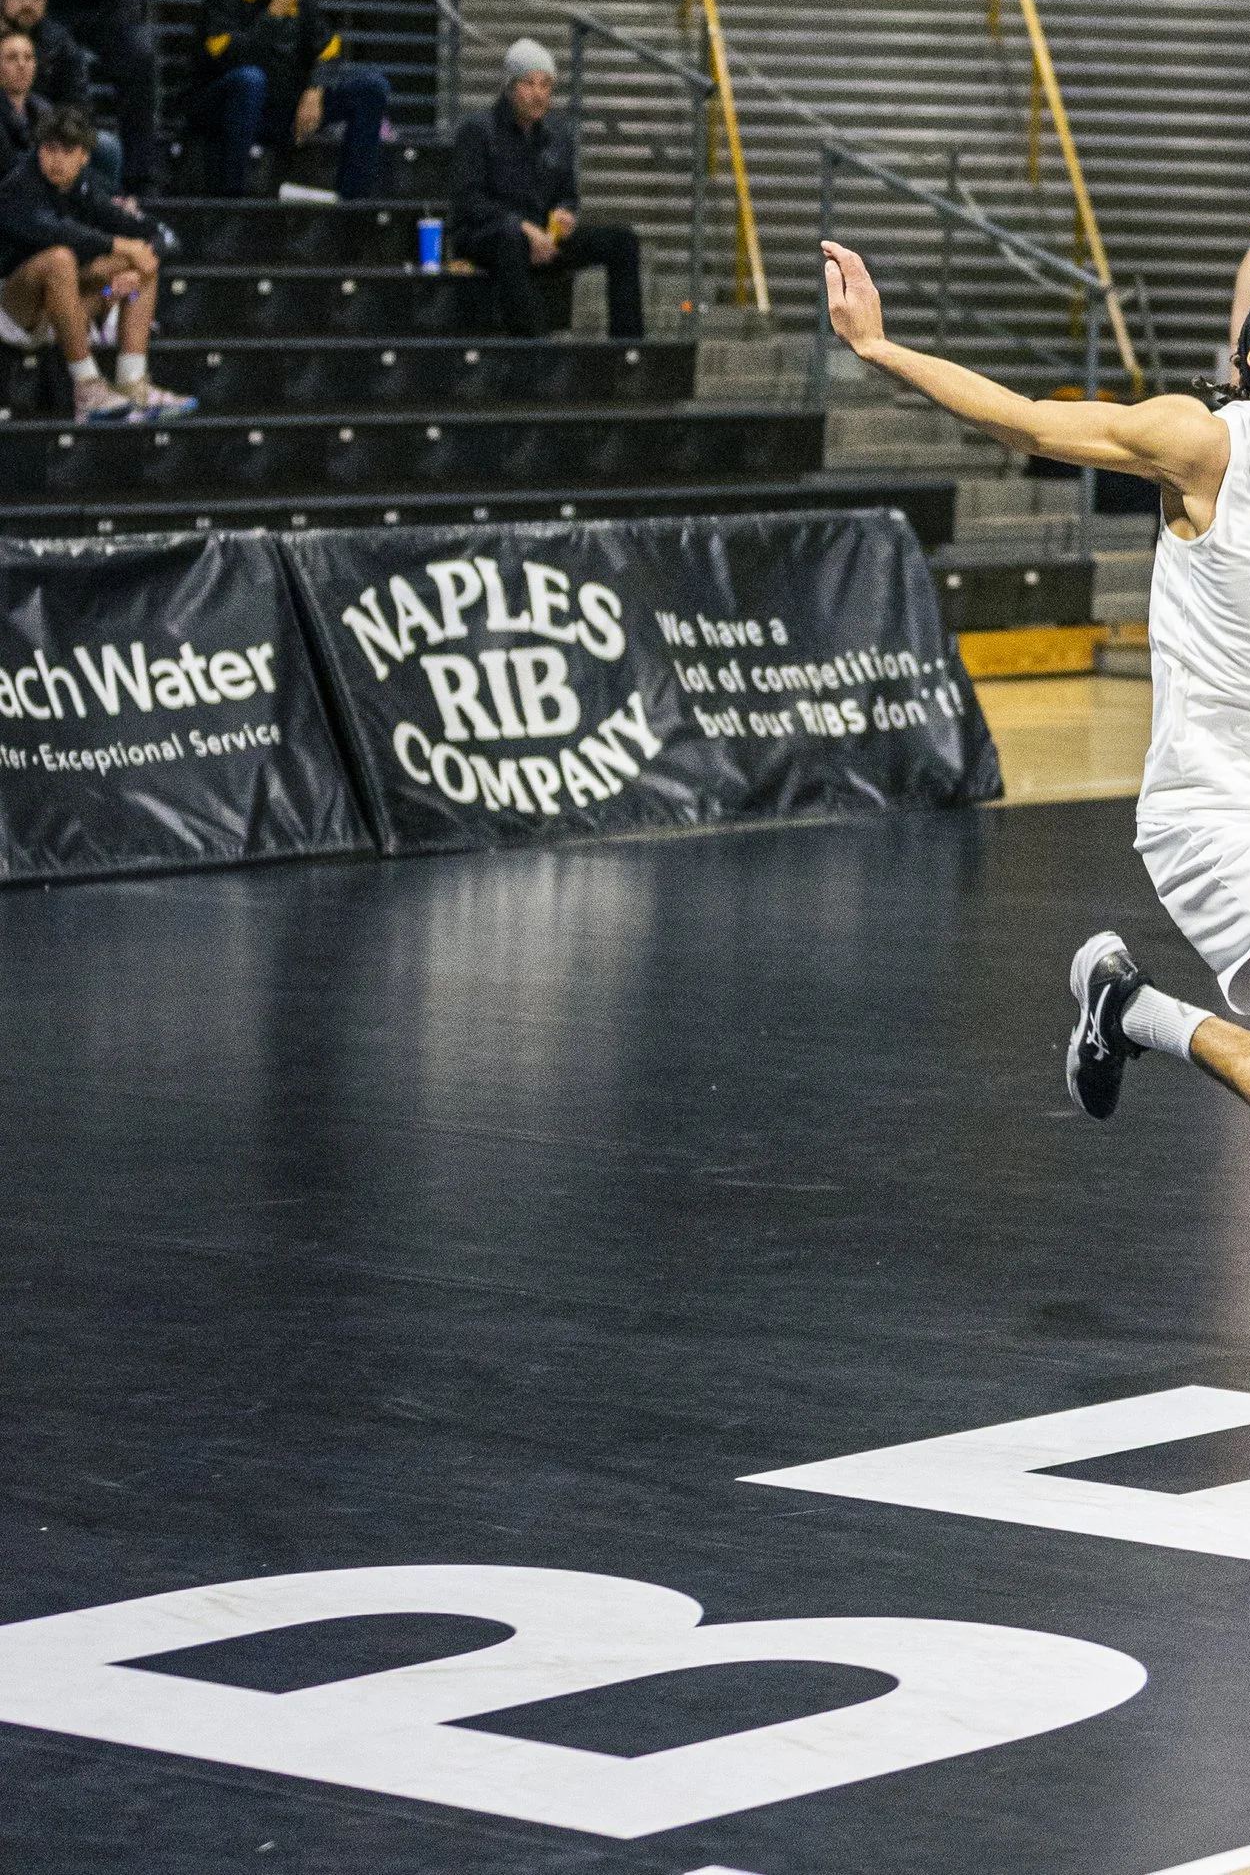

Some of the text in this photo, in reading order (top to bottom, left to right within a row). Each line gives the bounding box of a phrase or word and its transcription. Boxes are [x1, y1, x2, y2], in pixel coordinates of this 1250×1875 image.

[342, 557, 626, 681] NAPLES
[655, 612, 788, 649] We have a
[74, 642, 276, 715] Water
[421, 645, 580, 740] RIB
[675, 659, 715, 695] lot
[719, 655, 747, 694] of
[39, 733, 184, 775] Exceptional
[189, 724, 282, 757] Service
[695, 706, 747, 739] but
[751, 705, 795, 737] our
[799, 699, 865, 737] RIBS
[393, 692, 663, 815] COMPANY
